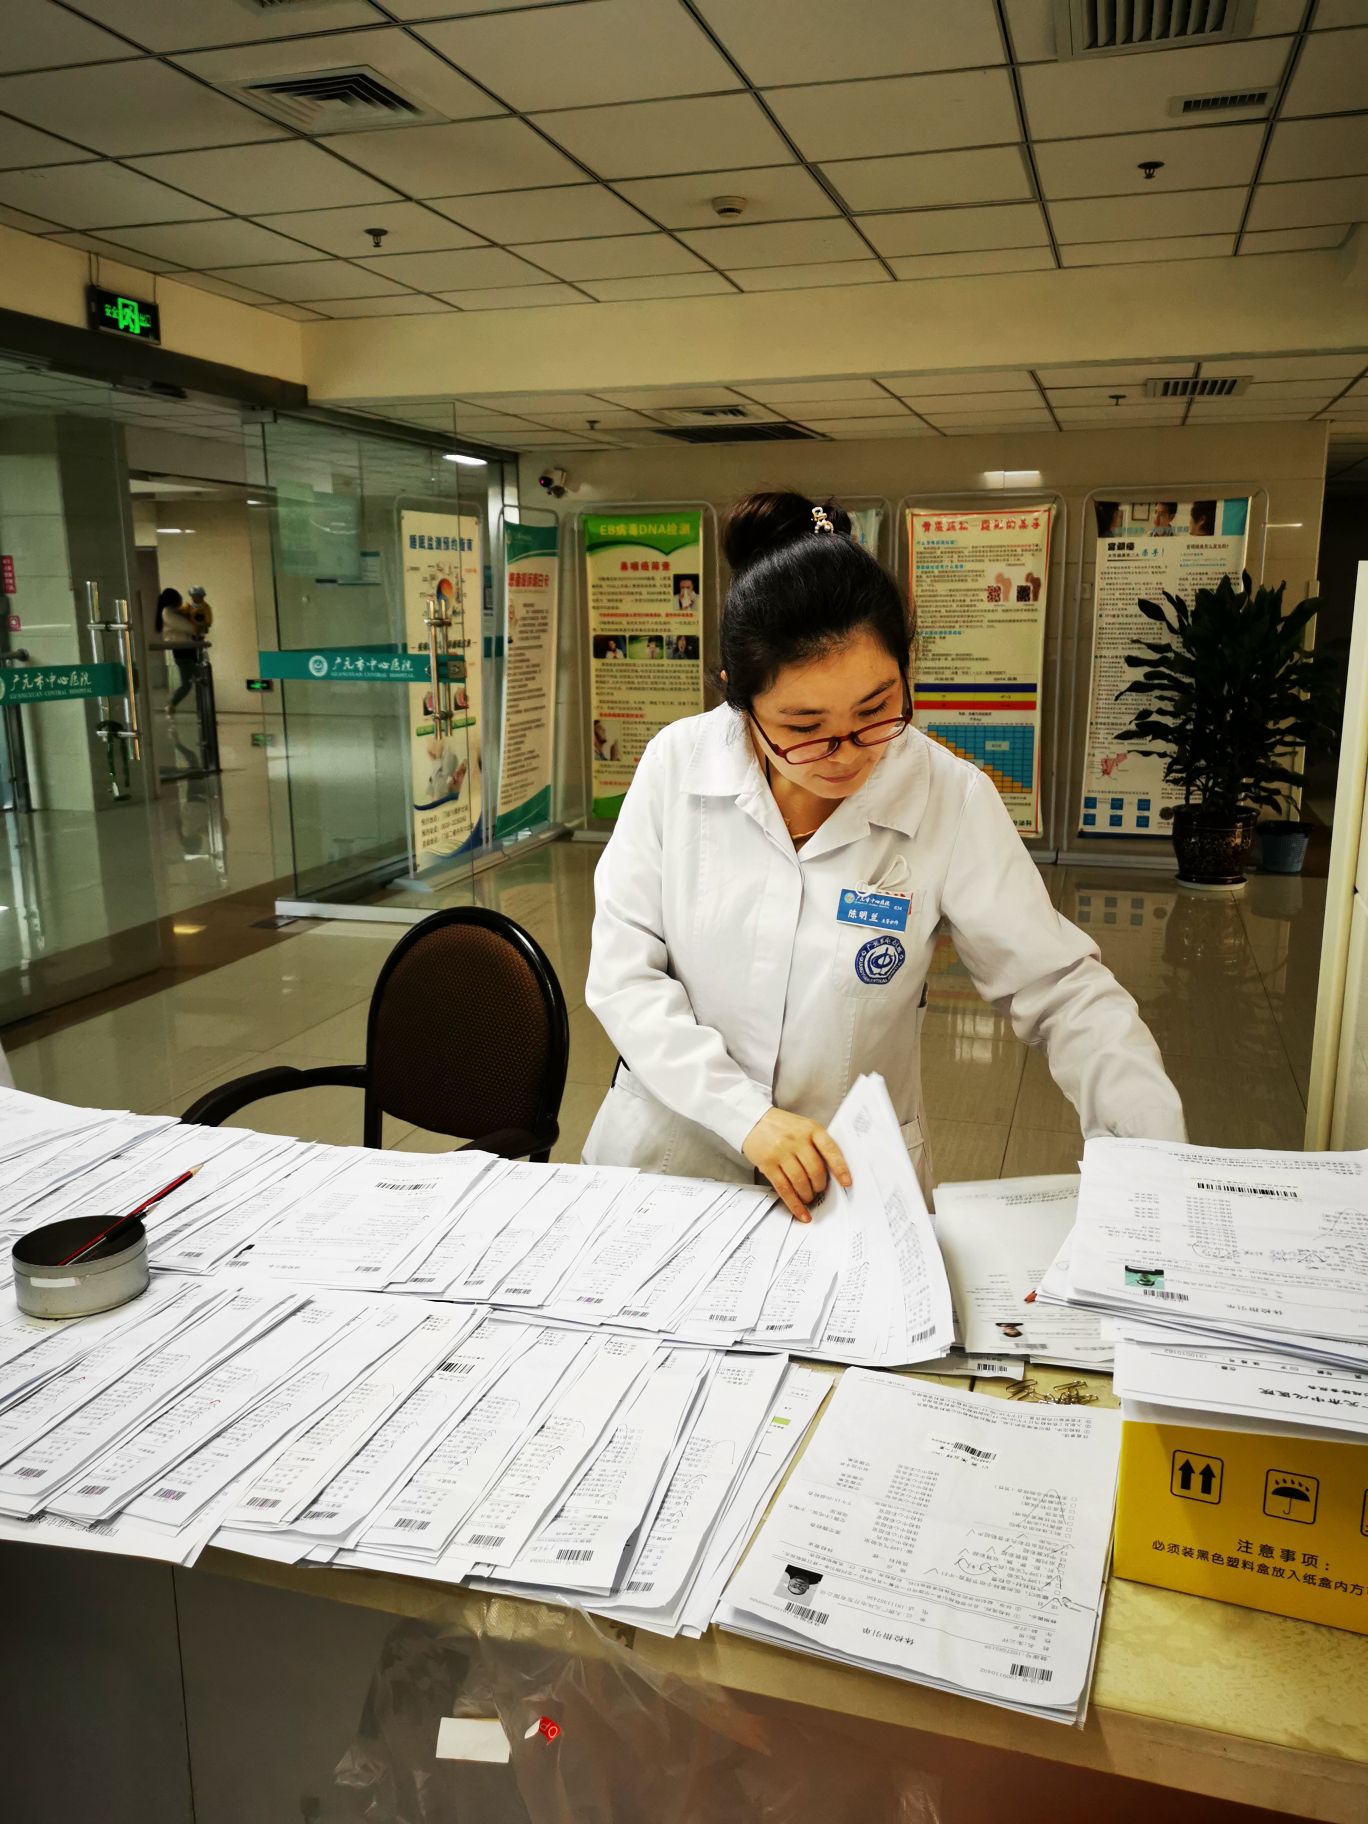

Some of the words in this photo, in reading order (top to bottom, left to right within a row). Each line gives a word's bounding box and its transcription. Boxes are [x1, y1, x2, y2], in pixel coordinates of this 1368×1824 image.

[332, 656, 414, 671] 广元市中心医院
[10, 670, 92, 691] 广元市中心医院
[1257, 1387, 1368, 1410] 元市中心医院
[1151, 1539, 1368, 1597] 必须装黑色塑料盒放入纸盒内方
[862, 1627, 914, 1646] 体检指引单
